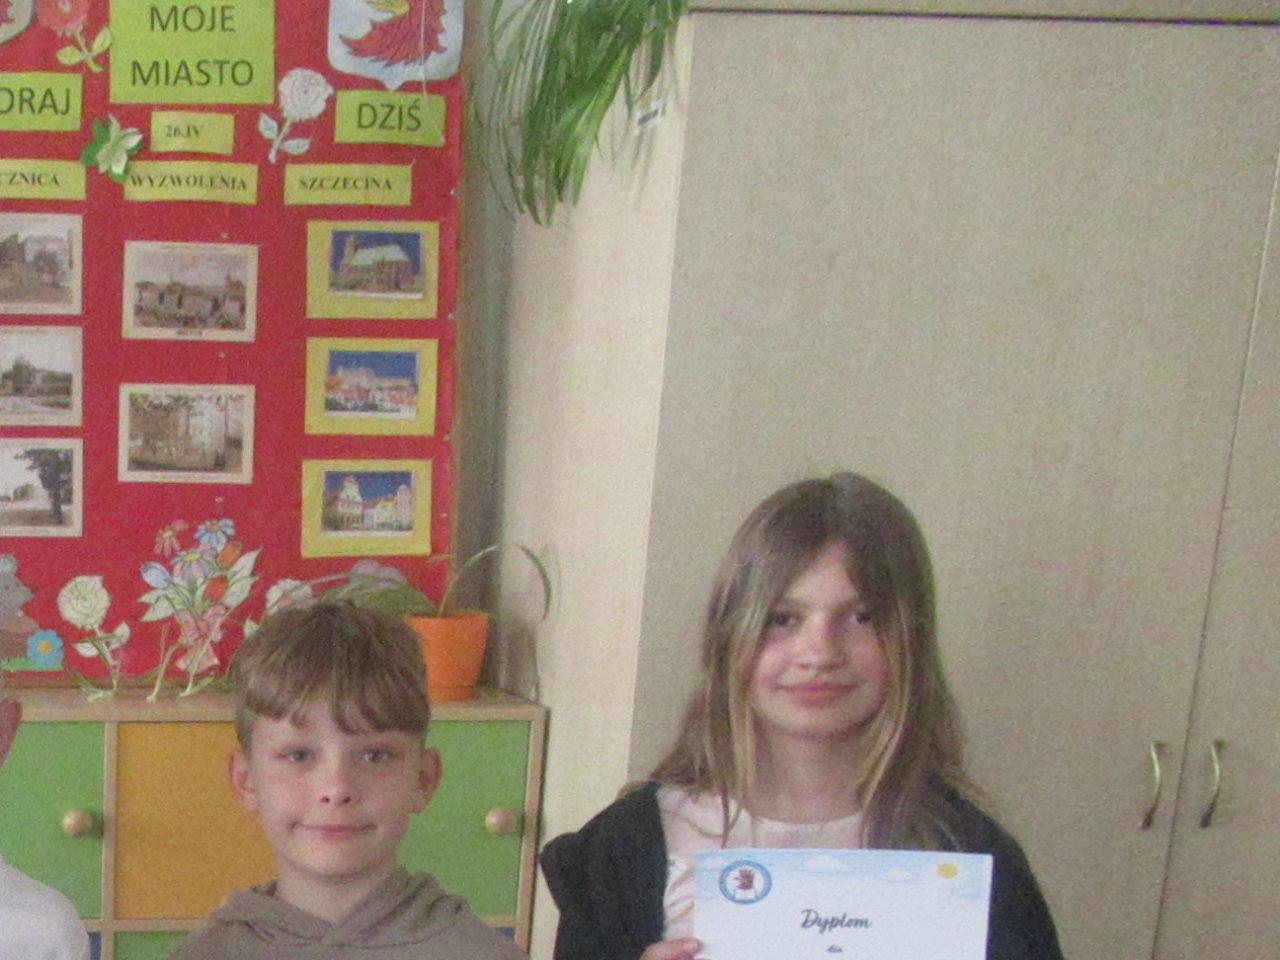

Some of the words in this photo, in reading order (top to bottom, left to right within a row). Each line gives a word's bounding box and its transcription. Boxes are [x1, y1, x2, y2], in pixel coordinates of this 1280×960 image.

[149, 5, 236, 33] MOJE
[131, 59, 254, 87] MIASTO
[357, 99, 422, 132] DZIŚ
[130, 174, 248, 192] WYZWOLENIA
[299, 176, 393, 191] SZCZECINA
[801, 909, 871, 934] Dyplom
